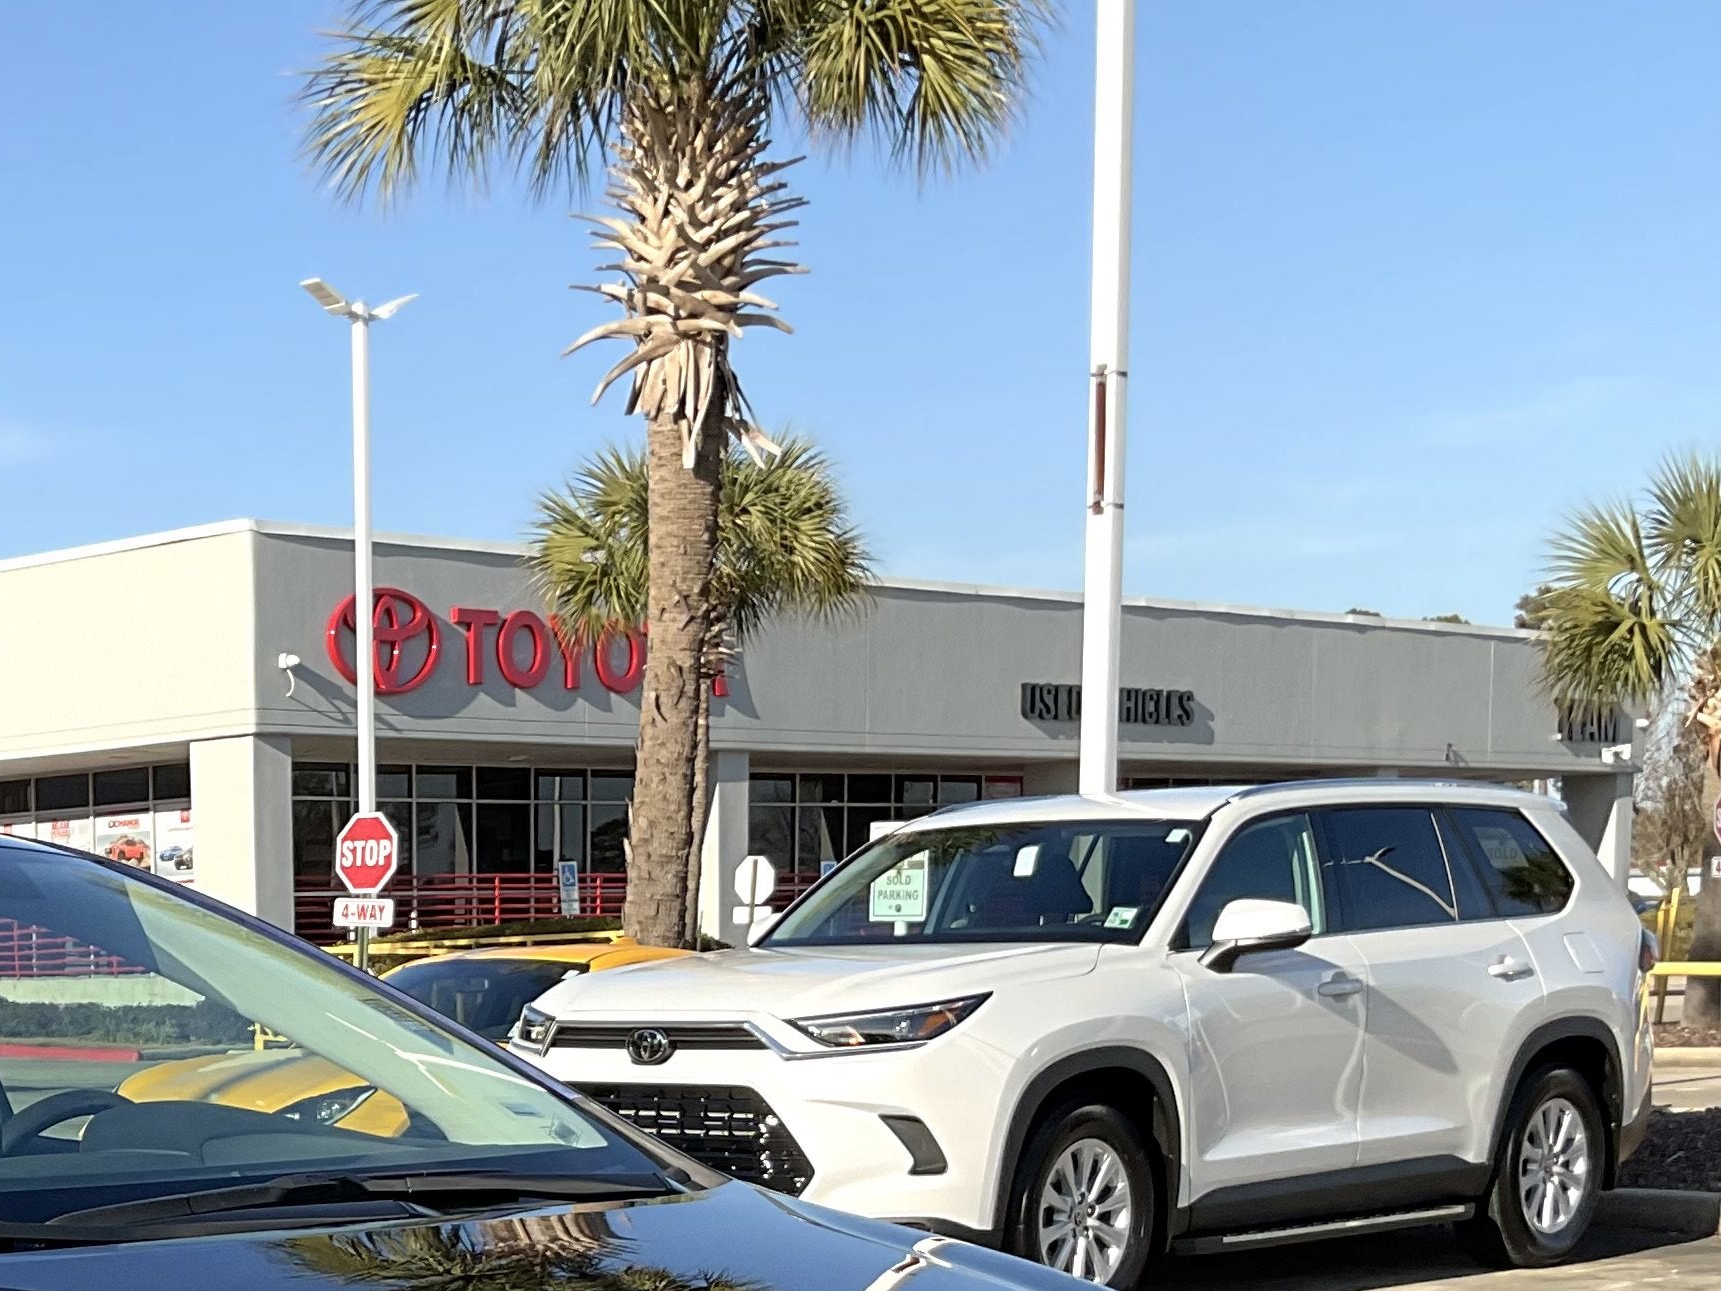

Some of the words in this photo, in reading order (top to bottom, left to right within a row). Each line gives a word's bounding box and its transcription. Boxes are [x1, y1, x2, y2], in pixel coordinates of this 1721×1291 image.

[450, 607, 729, 697] TOYO
[1118, 687, 1195, 727] HICLES
[341, 839, 391, 868] STOP
[886, 875, 912, 886] SOLD
[878, 889, 919, 901] PARKING
[341, 903, 386, 921] 4-WAY
